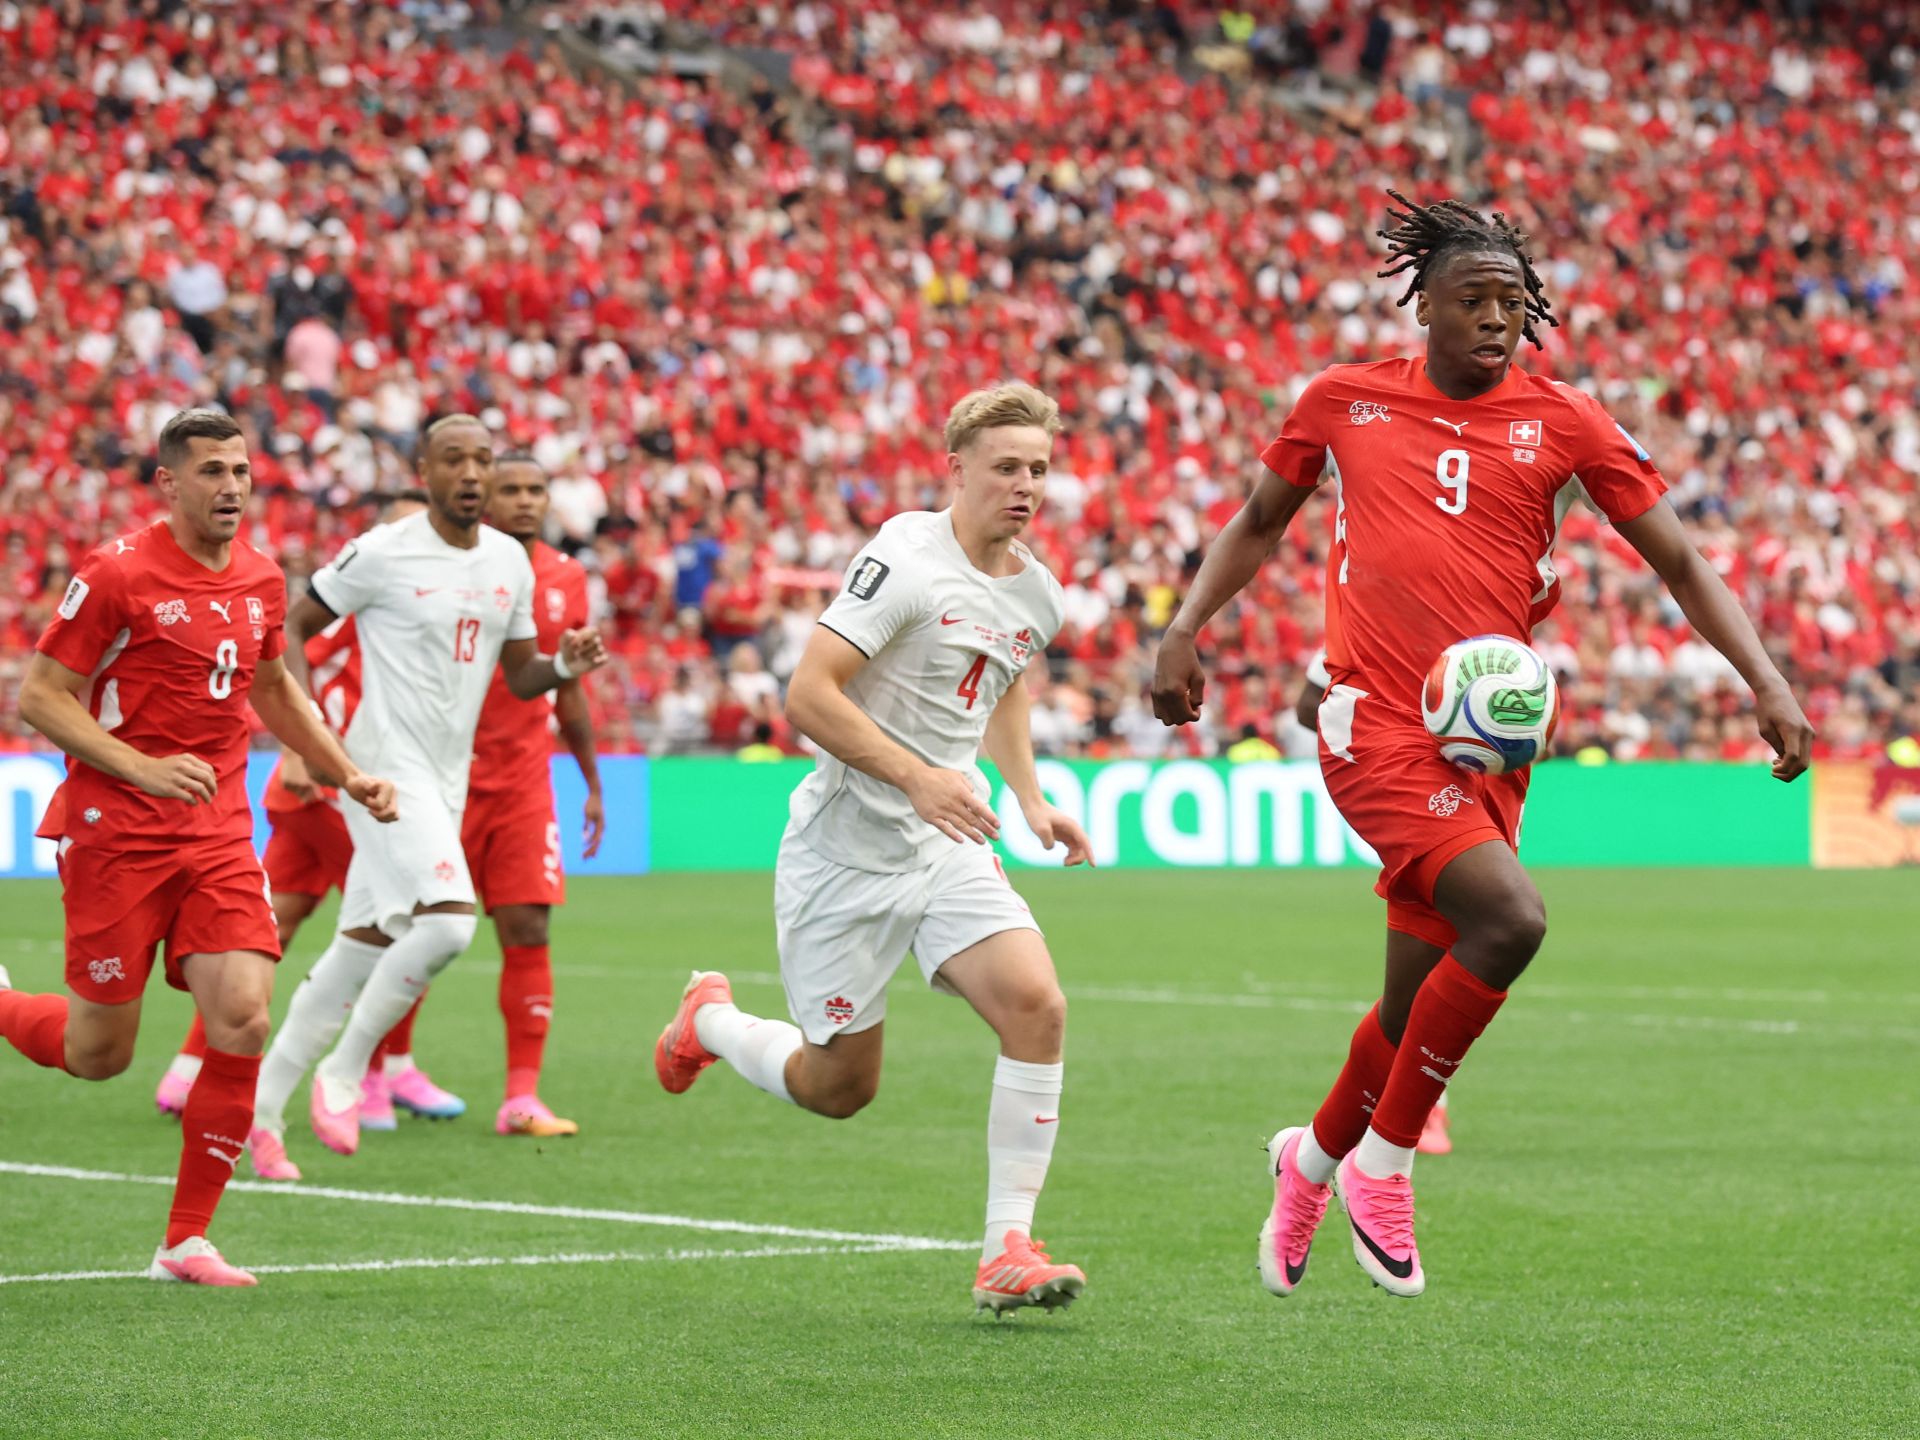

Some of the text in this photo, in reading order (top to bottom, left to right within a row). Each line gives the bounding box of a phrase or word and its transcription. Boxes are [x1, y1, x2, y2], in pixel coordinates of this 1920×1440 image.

[1436, 449, 1470, 515] 9
[208, 639, 238, 700] 8
[453, 618, 481, 663] 13
[957, 654, 989, 710] 4
